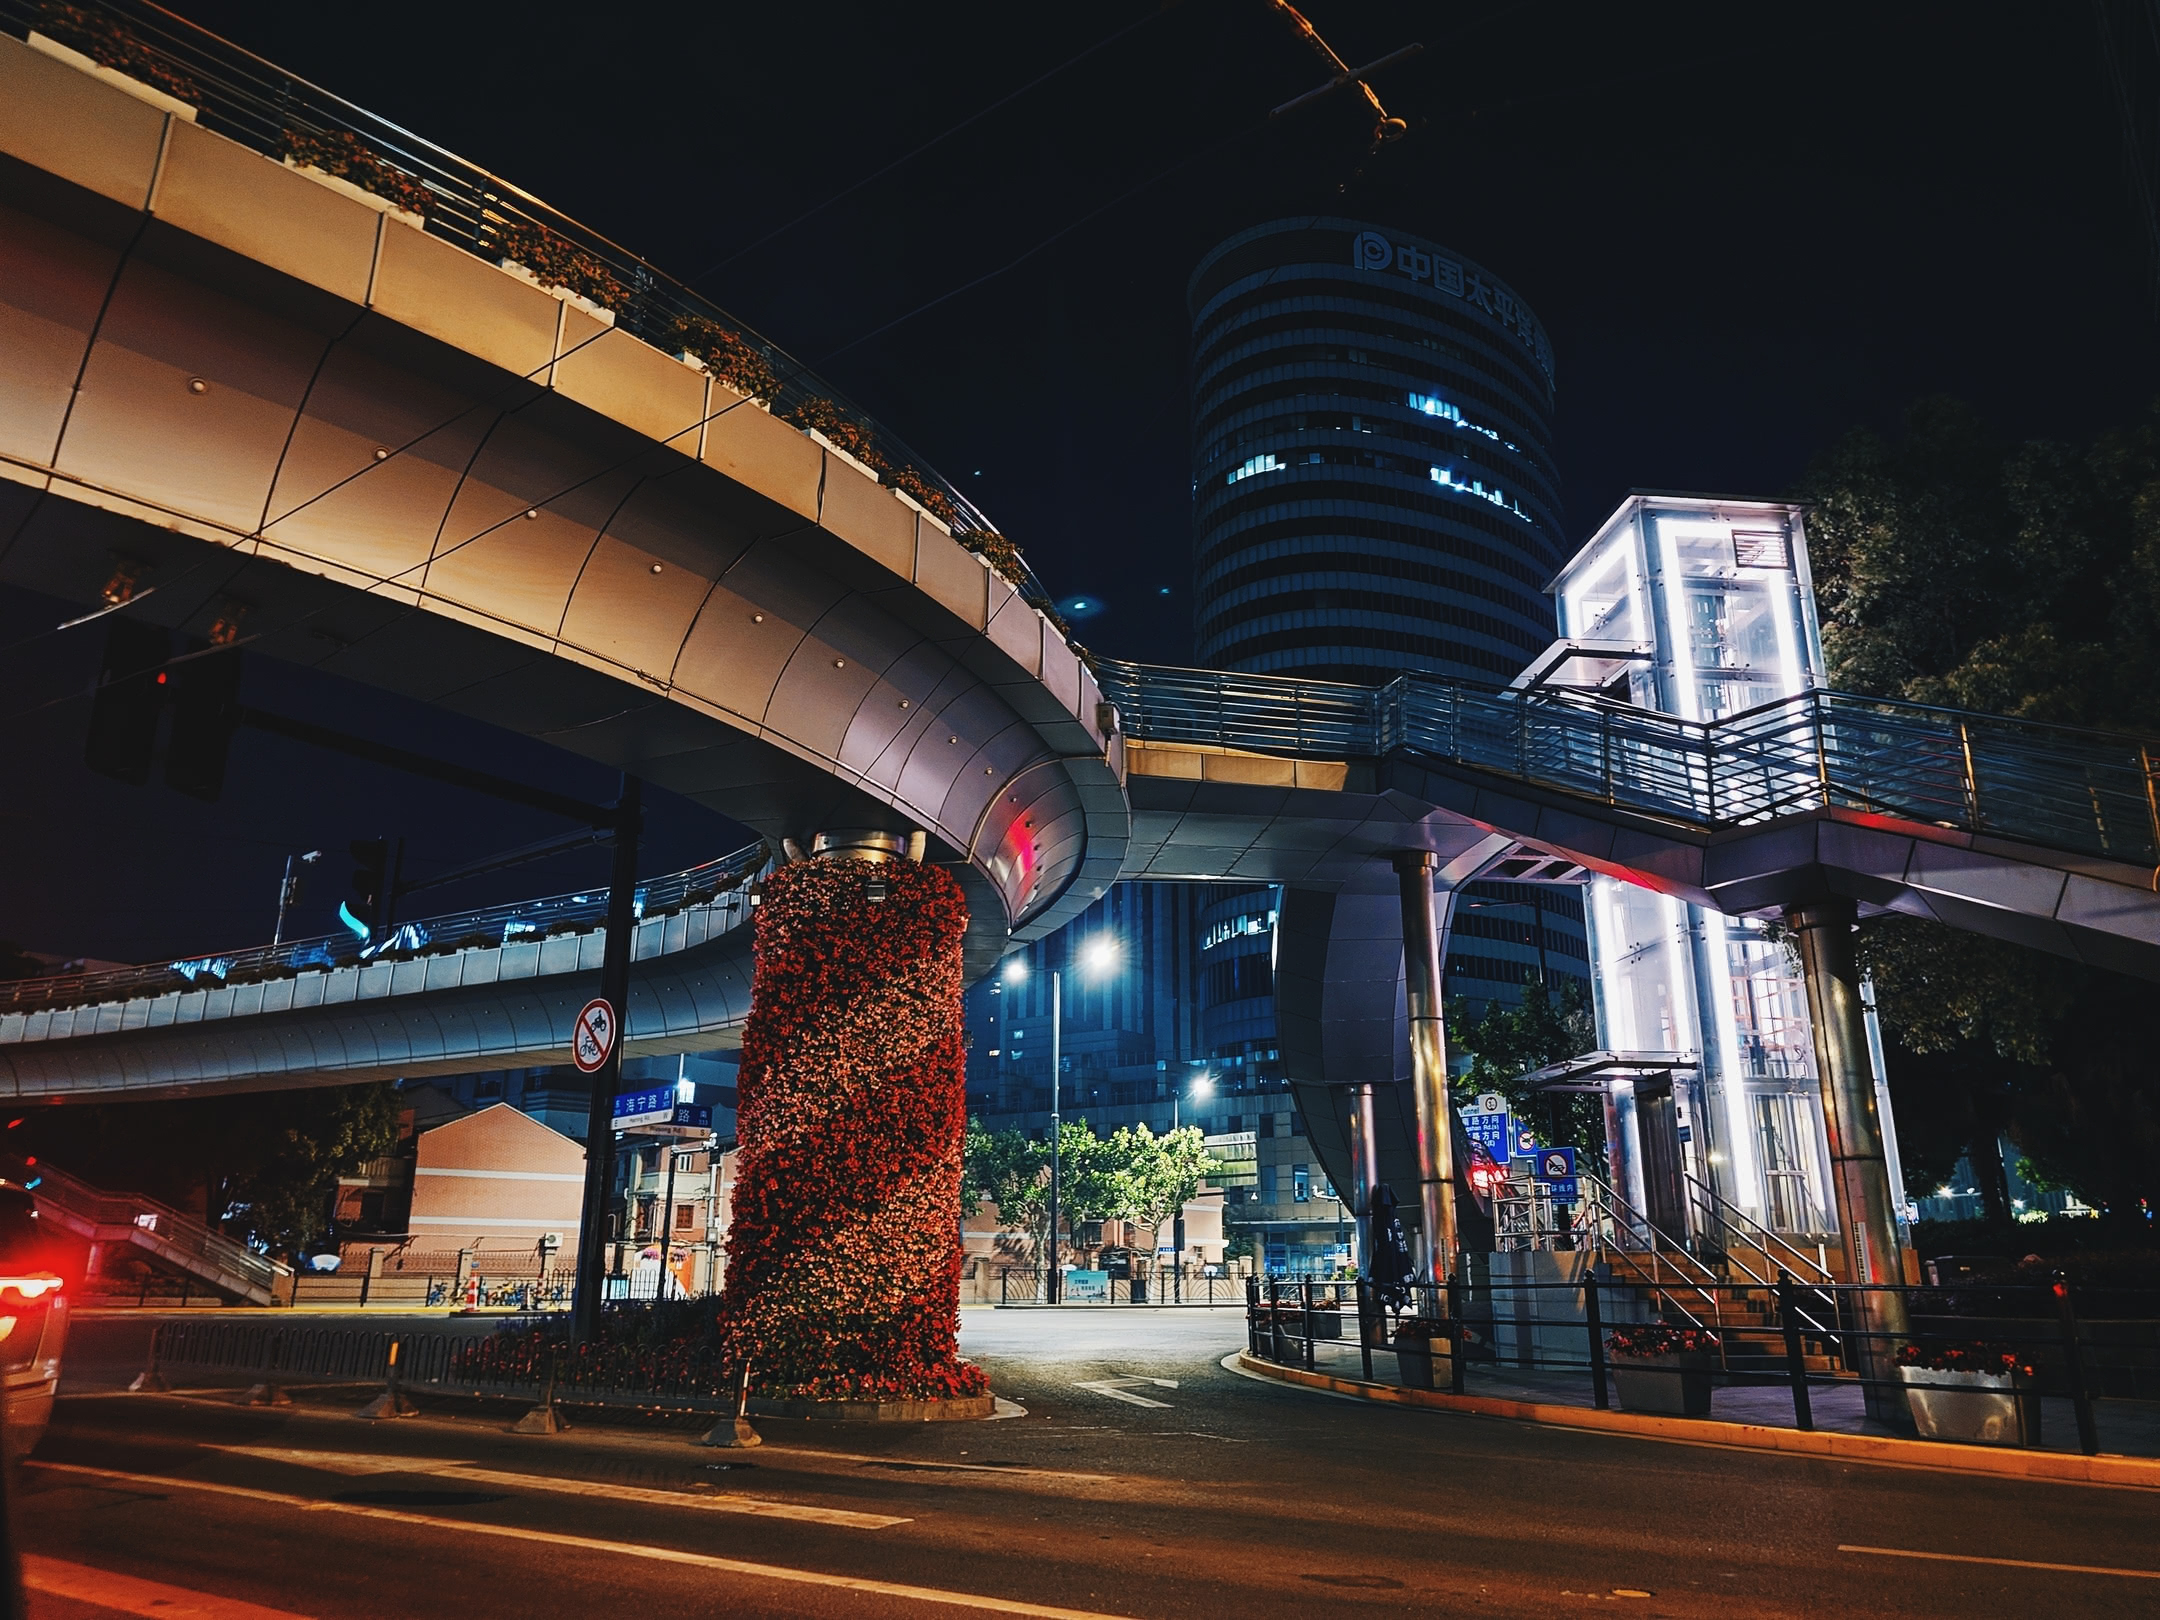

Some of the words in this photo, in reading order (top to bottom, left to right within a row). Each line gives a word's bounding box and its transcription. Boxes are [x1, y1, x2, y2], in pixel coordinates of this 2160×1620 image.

[625, 1094, 657, 1112] 海宁路
[678, 1109, 690, 1122] 路
